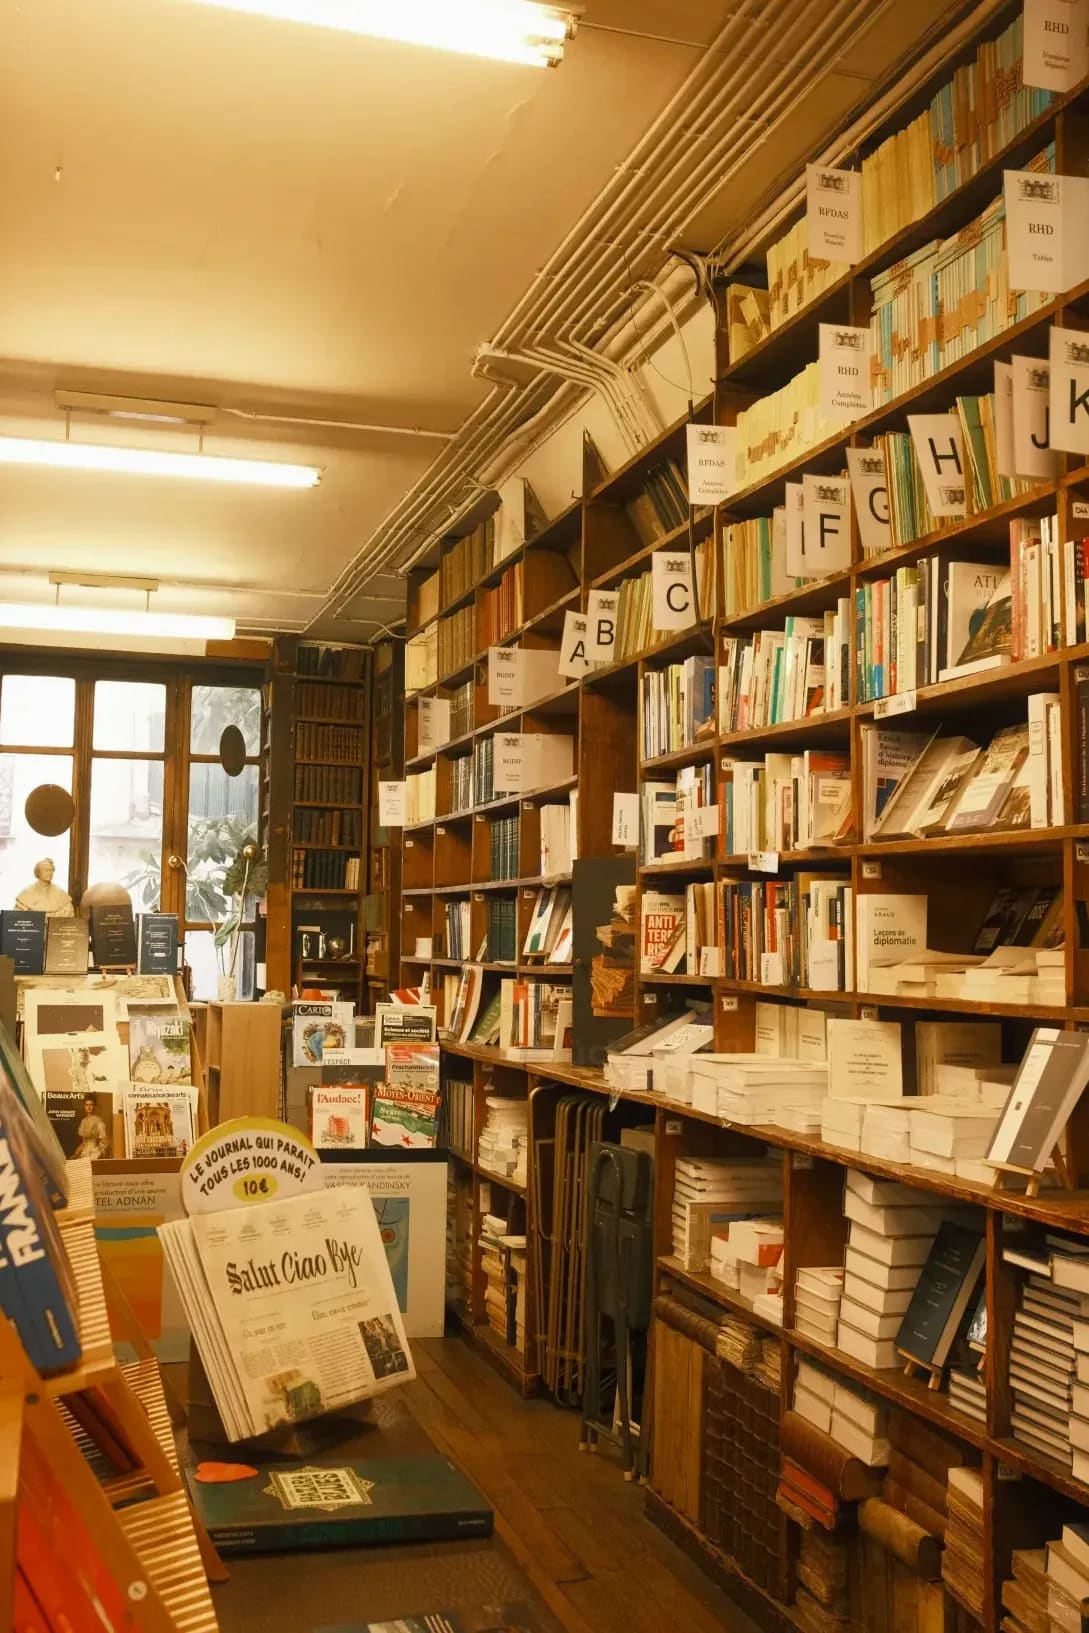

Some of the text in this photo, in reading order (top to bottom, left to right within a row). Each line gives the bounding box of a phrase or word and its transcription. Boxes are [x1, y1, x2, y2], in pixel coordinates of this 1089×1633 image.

[1044, 20, 1070, 35] RHD
[818, 206, 849, 220] RFDAS
[1028, 223, 1054, 236] RHD
[837, 365, 859, 376] RHD
[1070, 378, 1089, 424] K
[1030, 407, 1049, 450] J
[927, 436, 962, 475] H
[868, 487, 890, 524] G
[819, 513, 841, 549] F
[666, 583, 689, 612] C
[597, 619, 615, 646] B
[569, 640, 589, 667] A
[878, 759, 907, 768] diploma
[648, 915, 673, 929] ANTI
[873, 928, 897, 939] Leçons
[873, 935, 917, 946] diplomatie
[377, 1086, 435, 1103] MOYEN-ORIENT
[190, 1137, 315, 1183] LE JOURNAL QUI PARAIT
[200, 1156, 306, 1196] TOUS LES 1000 ANS!
[94, 1188, 128, 1196] production
[243, 1178, 269, 1196] 10€
[95, 1196, 156, 1207] TEL ADNAN
[226, 1238, 363, 1295] Salut Ciao Bye
